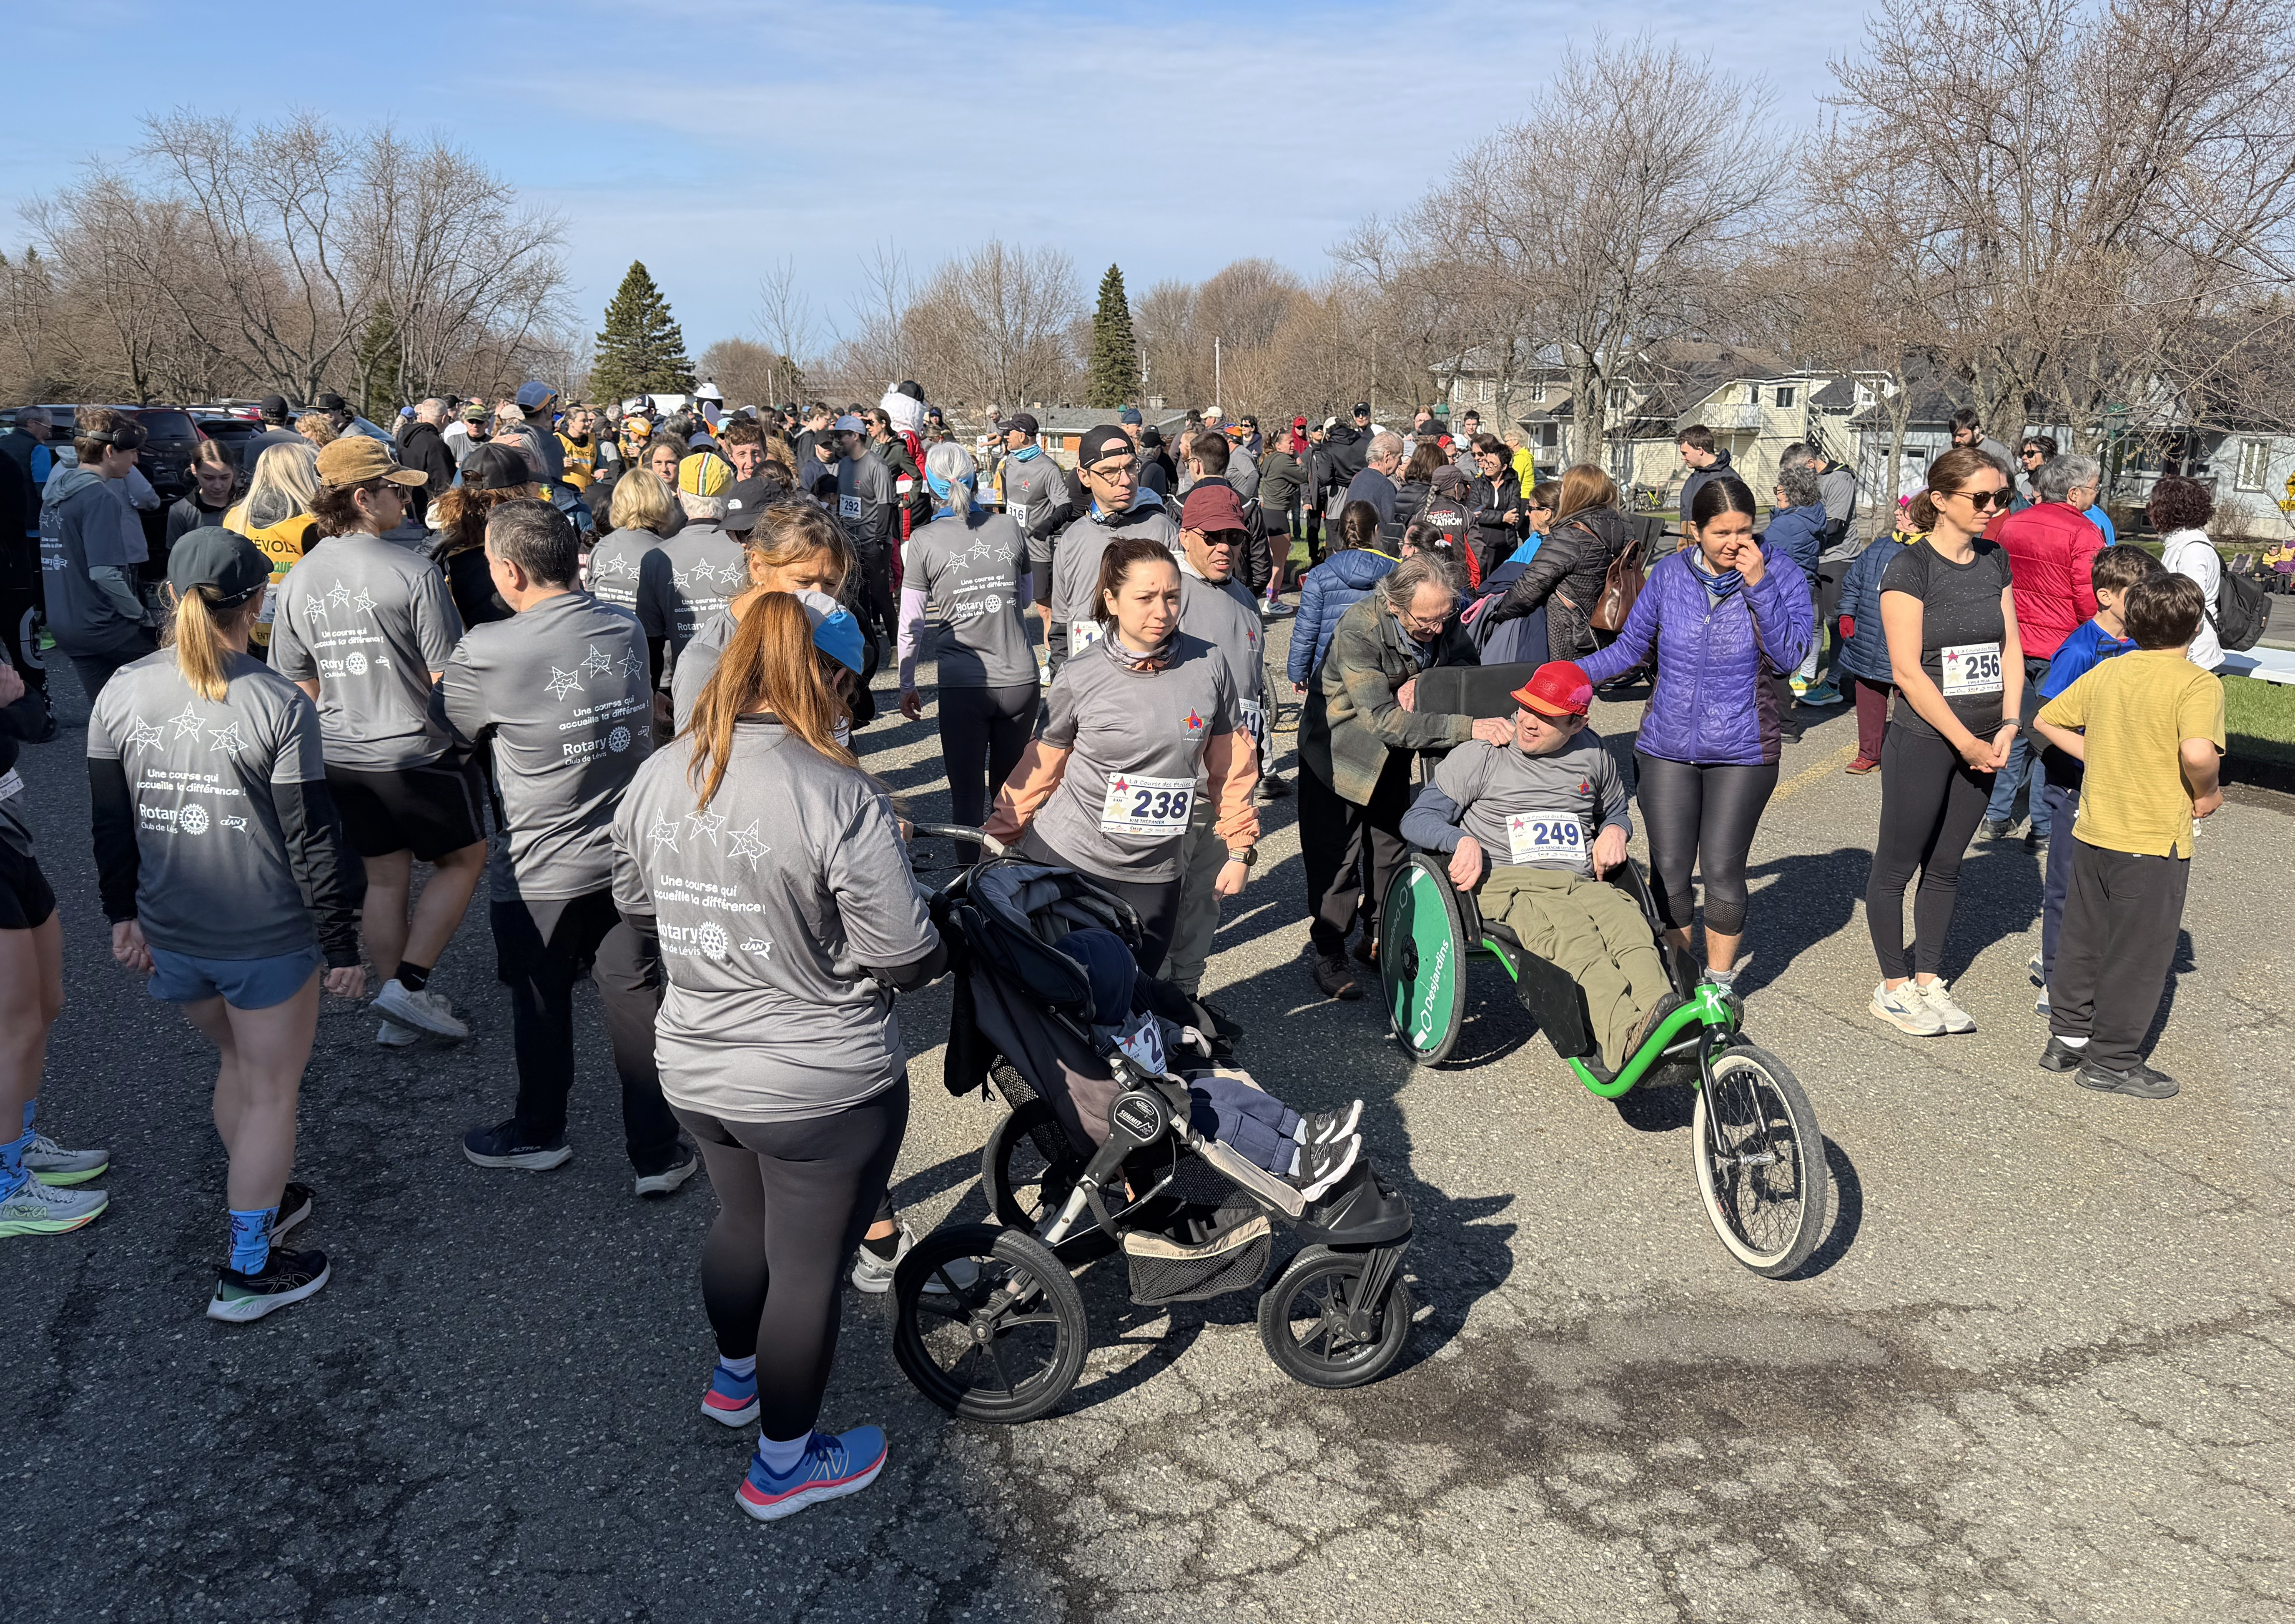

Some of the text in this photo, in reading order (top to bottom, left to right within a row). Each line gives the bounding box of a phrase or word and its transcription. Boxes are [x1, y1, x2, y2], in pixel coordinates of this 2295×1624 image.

[844, 500, 859, 512] 292
[1009, 506, 1023, 520] 316
[956, 600, 984, 612] Rotary
[677, 622, 705, 631] Rotary
[1965, 654, 2000, 680] 256
[573, 695, 635, 717] Une course qui
[559, 716, 599, 730] accueille
[612, 703, 646, 718] différence
[563, 737, 607, 756] Rotary
[565, 757, 581, 766] Club
[592, 751, 607, 760] Lévis
[147, 769, 219, 784] Une course qui
[177, 782, 185, 791] la
[186, 783, 239, 796] différence
[139, 803, 178, 824] Rotary
[1131, 789, 1188, 820] 238
[141, 822, 155, 830] Club
[1533, 822, 1579, 846] 249
[661, 875, 737, 898] Une course qui
[653, 888, 690, 902] ccueille
[691, 893, 700, 905] la
[702, 895, 762, 912] différence
[669, 944, 678, 954] de
[678, 945, 701, 956] Lévis
[1425, 939, 1449, 1012] Desjardins
[1119, 1109, 1143, 1127] SUMMIT
[1, 1204, 48, 1218] HOKA
